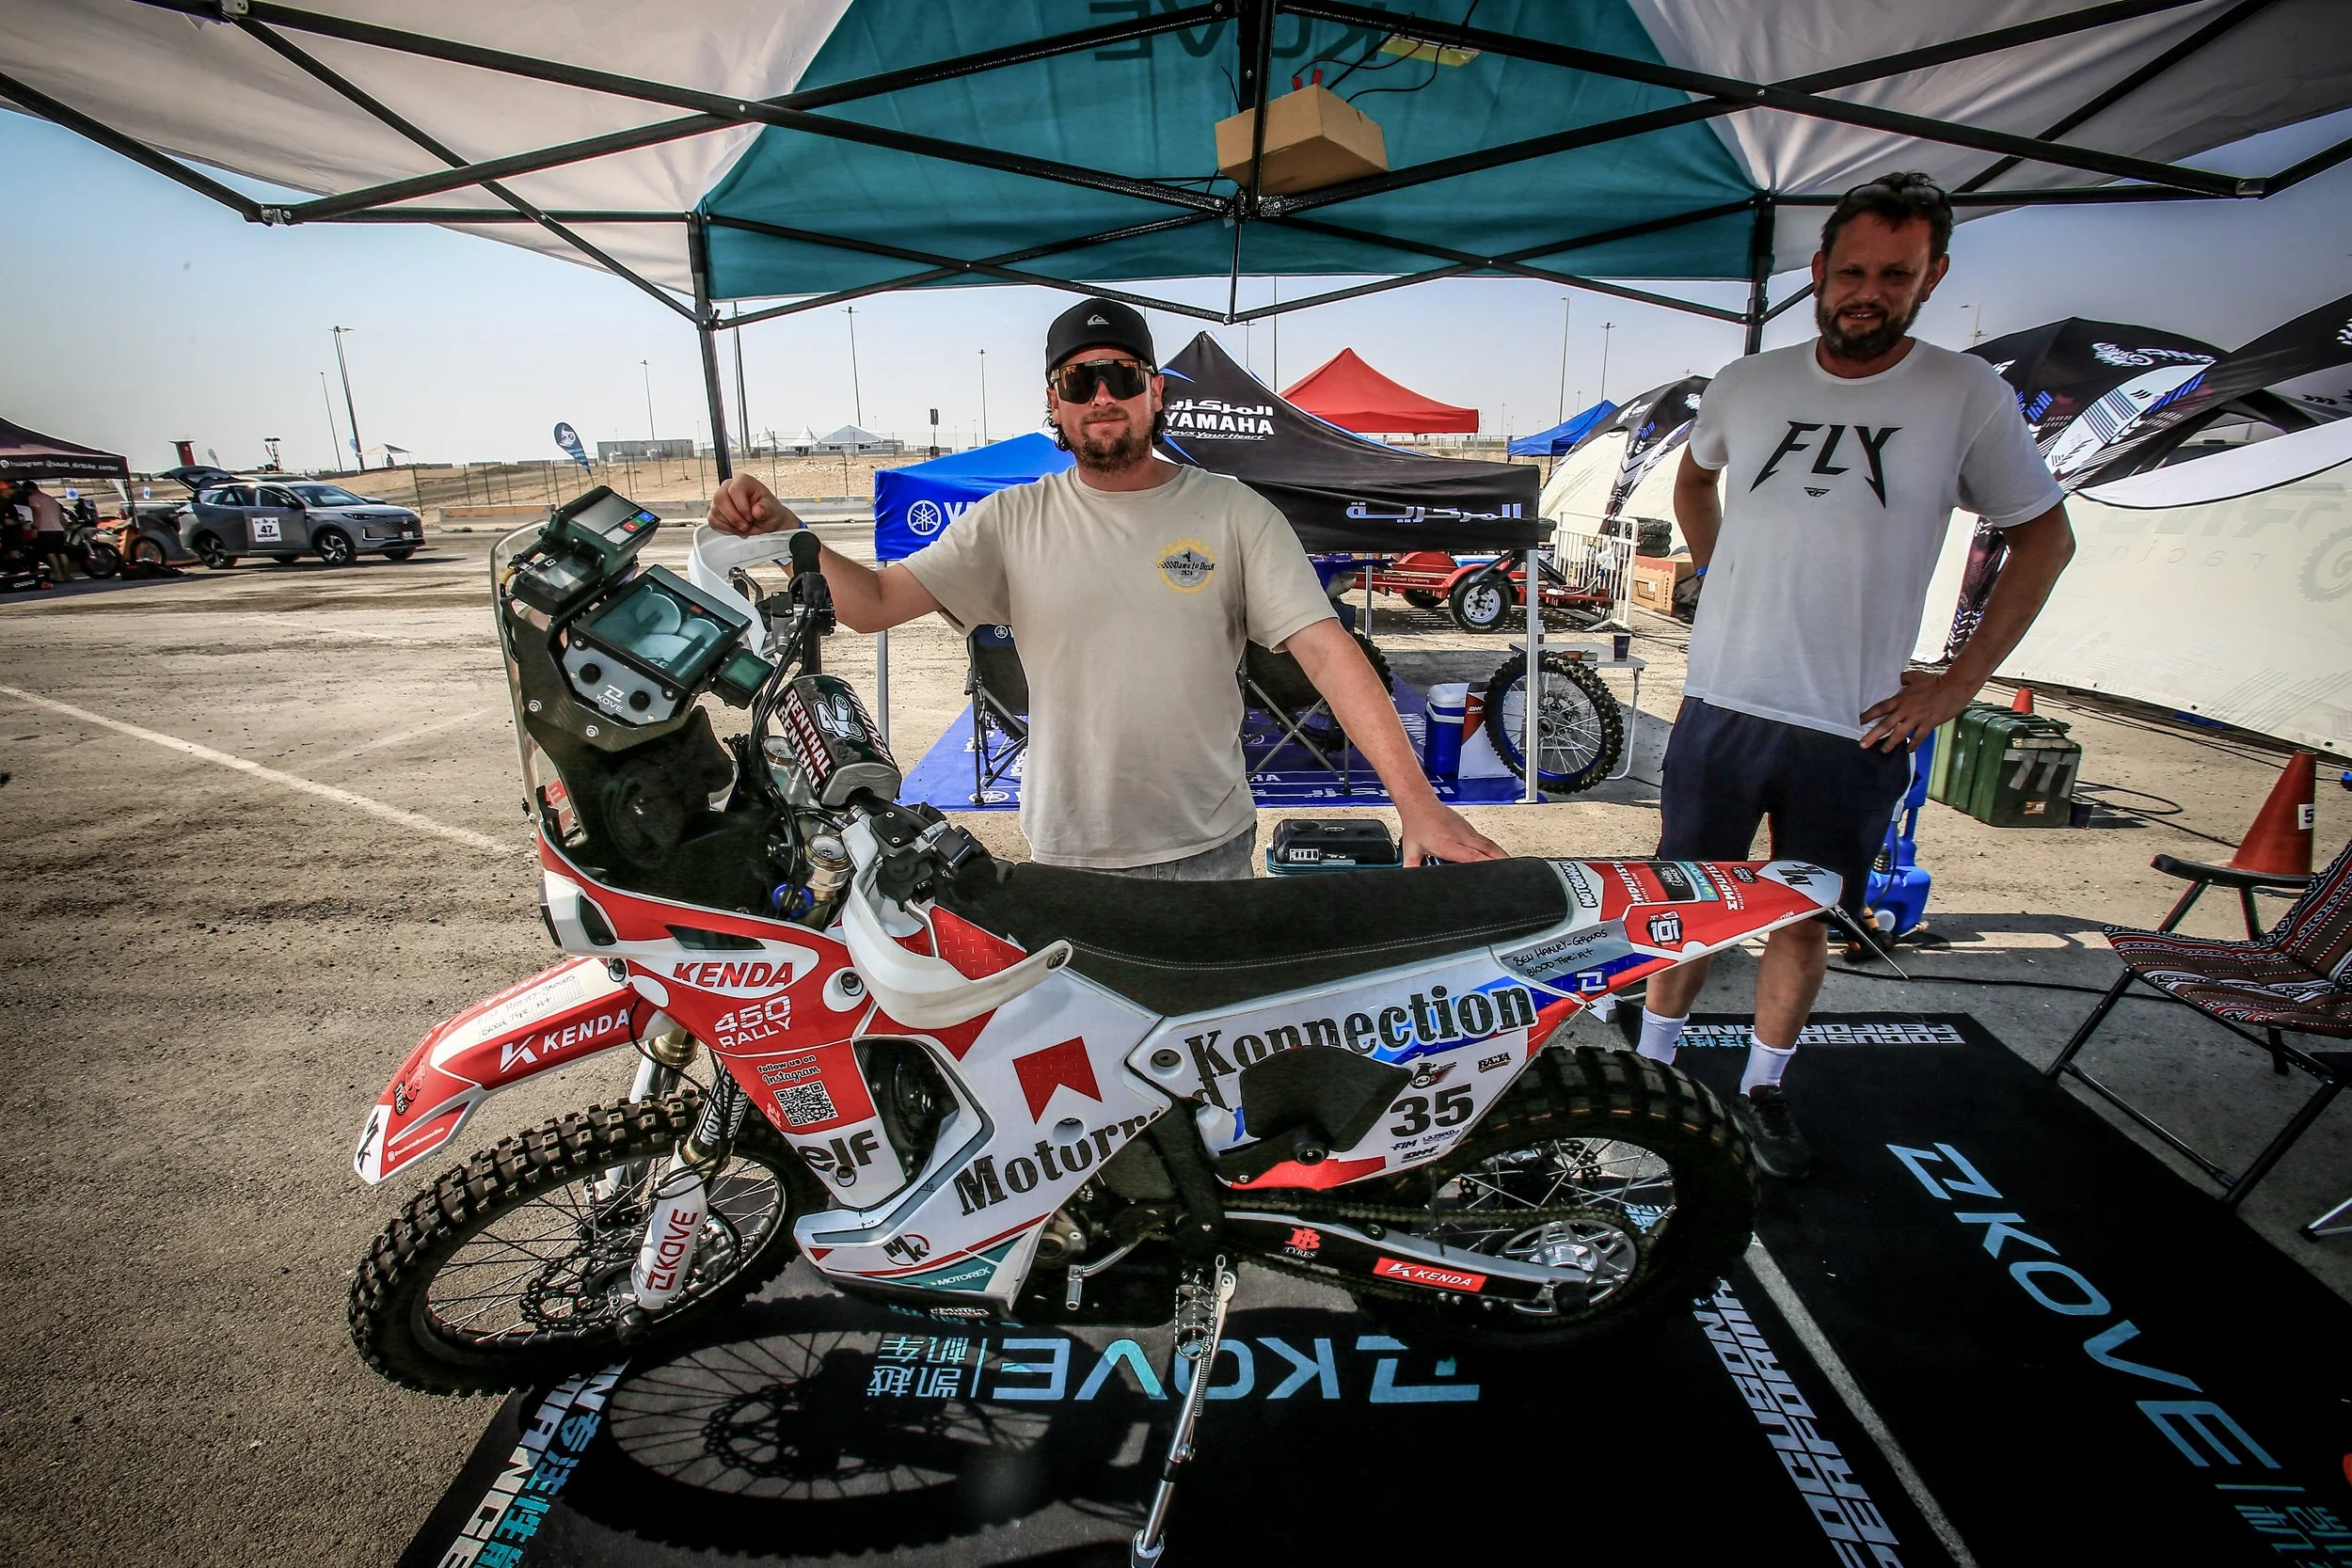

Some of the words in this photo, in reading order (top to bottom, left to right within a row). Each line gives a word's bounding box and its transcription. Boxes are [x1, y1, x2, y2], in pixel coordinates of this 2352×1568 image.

[1165, 412, 1275, 436] YAMAHA
[1749, 420, 1903, 509] FLY
[261, 525, 274, 534] 47
[596, 693, 624, 713] KOVE
[1650, 919, 1680, 942] 101
[673, 961, 794, 988] KENDA
[714, 995, 791, 1033] 450
[542, 1008, 631, 1055] KENDA
[718, 1017, 792, 1049] RALLY
[1184, 985, 1537, 1077] Konnection
[757, 1060, 787, 1073] follow
[788, 1057, 802, 1067] us
[803, 1054, 817, 1064] on
[762, 1066, 821, 1085] Instagram
[1391, 1083, 1474, 1138] 35
[797, 1130, 881, 1173] elf
[1392, 1139, 1418, 1151] FIM
[1285, 1246, 1317, 1259] TYRES
[937, 1266, 992, 1286] MOTOREX
[1414, 1270, 1473, 1287] KENDA
